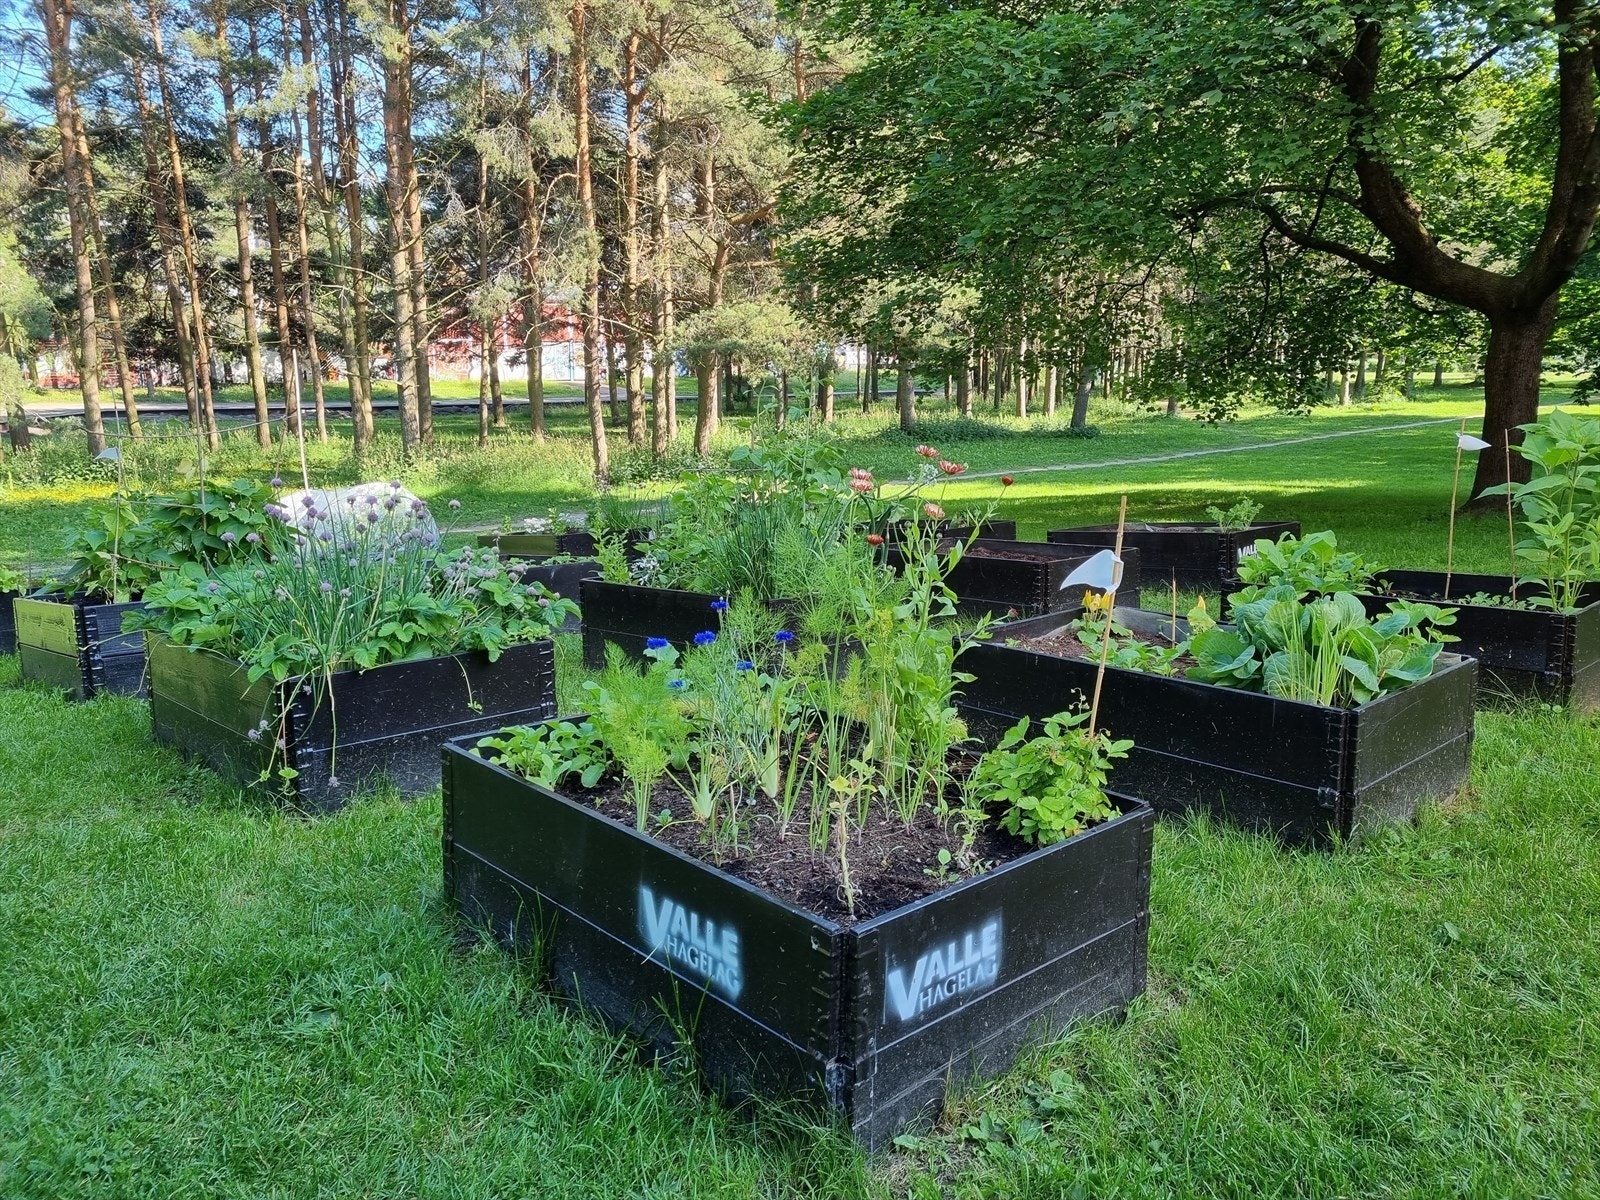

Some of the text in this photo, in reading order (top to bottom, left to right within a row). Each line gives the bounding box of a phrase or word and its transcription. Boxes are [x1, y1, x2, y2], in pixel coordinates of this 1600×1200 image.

[641, 887, 739, 968] VALLE
[666, 934, 740, 994] HAGELAG
[887, 922, 998, 1021] VALLE
[919, 955, 997, 1012] HAGELAG
